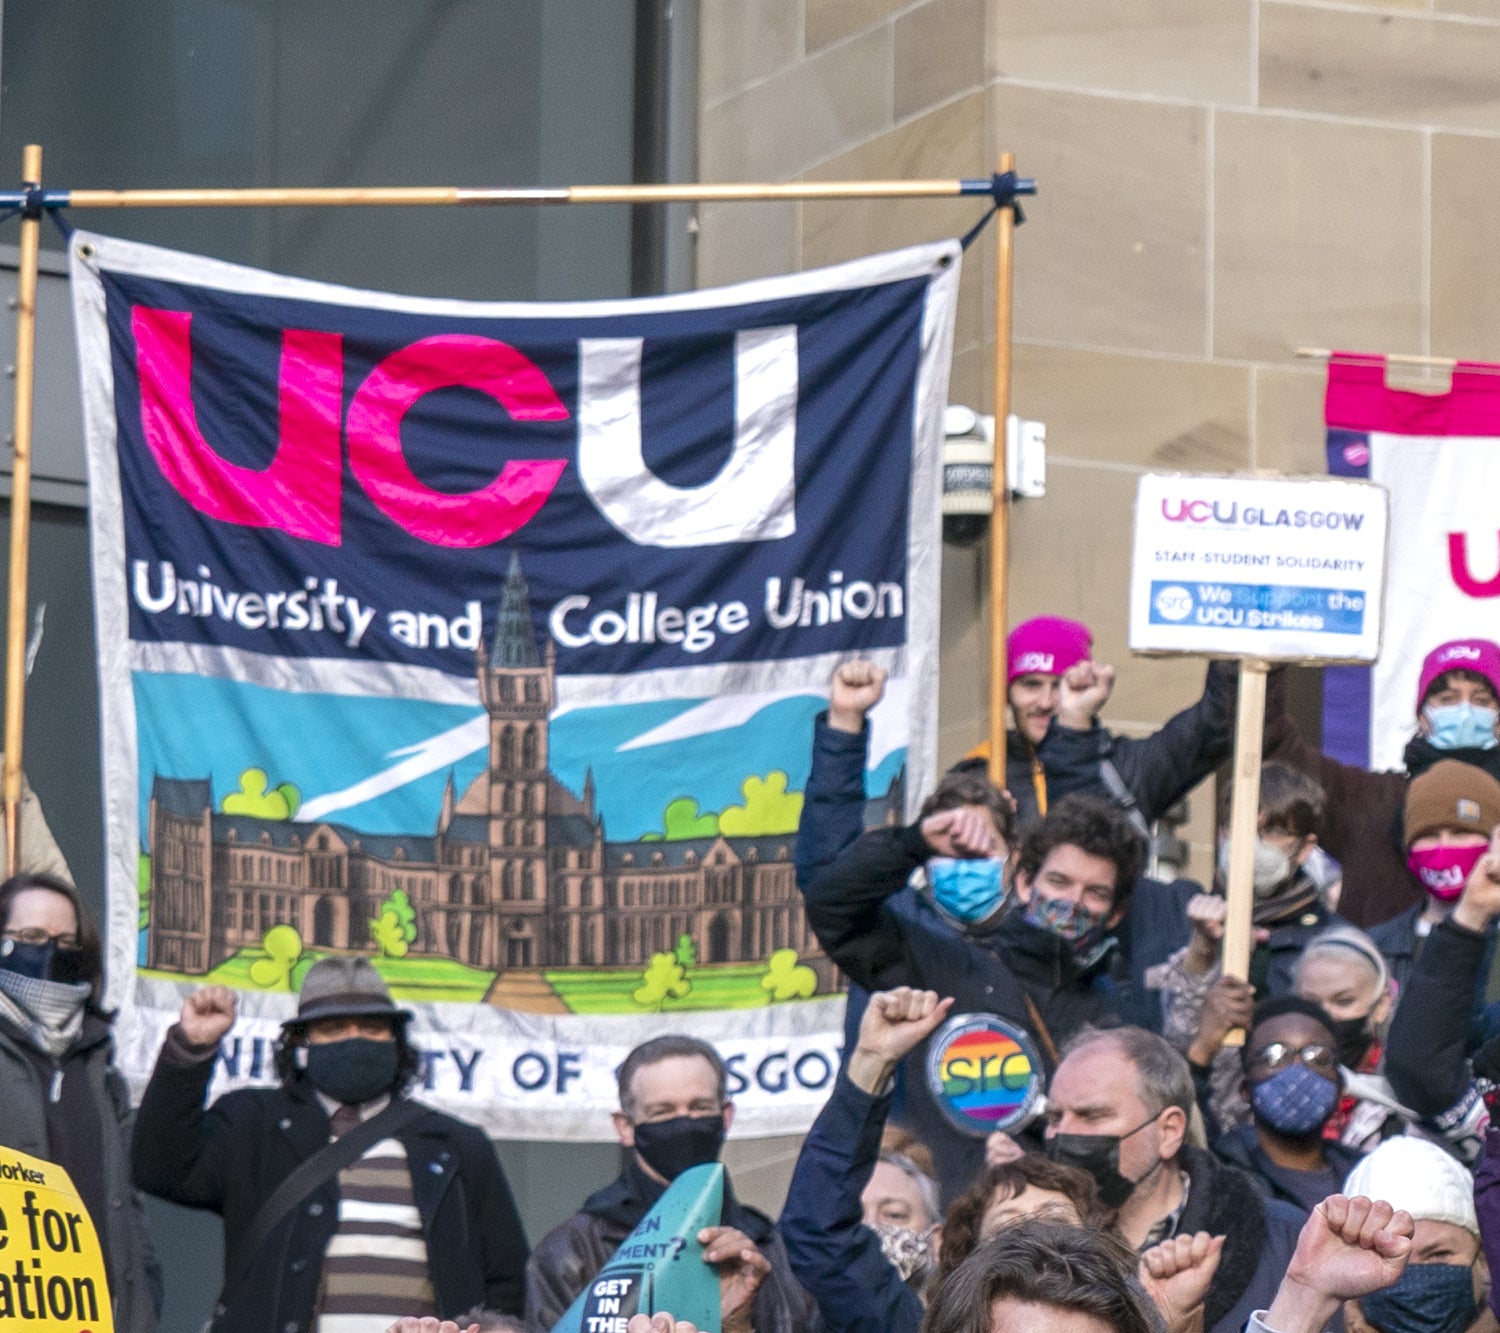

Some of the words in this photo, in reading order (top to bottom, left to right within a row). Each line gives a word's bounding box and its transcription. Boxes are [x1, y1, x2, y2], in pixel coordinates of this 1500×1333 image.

[131, 304, 799, 548] UCU
[1162, 497, 1238, 523] UCU
[1243, 507, 1364, 531] GLASGOW
[1277, 555, 1365, 571] SOLIDARITY
[131, 560, 376, 647] University
[388, 601, 482, 650] and
[549, 591, 749, 653] College
[765, 569, 905, 630] Union
[1198, 584, 1232, 603] We
[1328, 592, 1364, 610] the
[1197, 606, 1243, 626] UCU
[1246, 608, 1325, 630] Strikes
[512, 1051, 584, 1092] OF
[946, 1051, 1028, 1098] src
[0, 1160, 46, 1186] orker
[23, 1191, 82, 1253] for
[0, 1258, 100, 1322] ation
[594, 1278, 632, 1296] GET
[598, 1298, 620, 1315] IN
